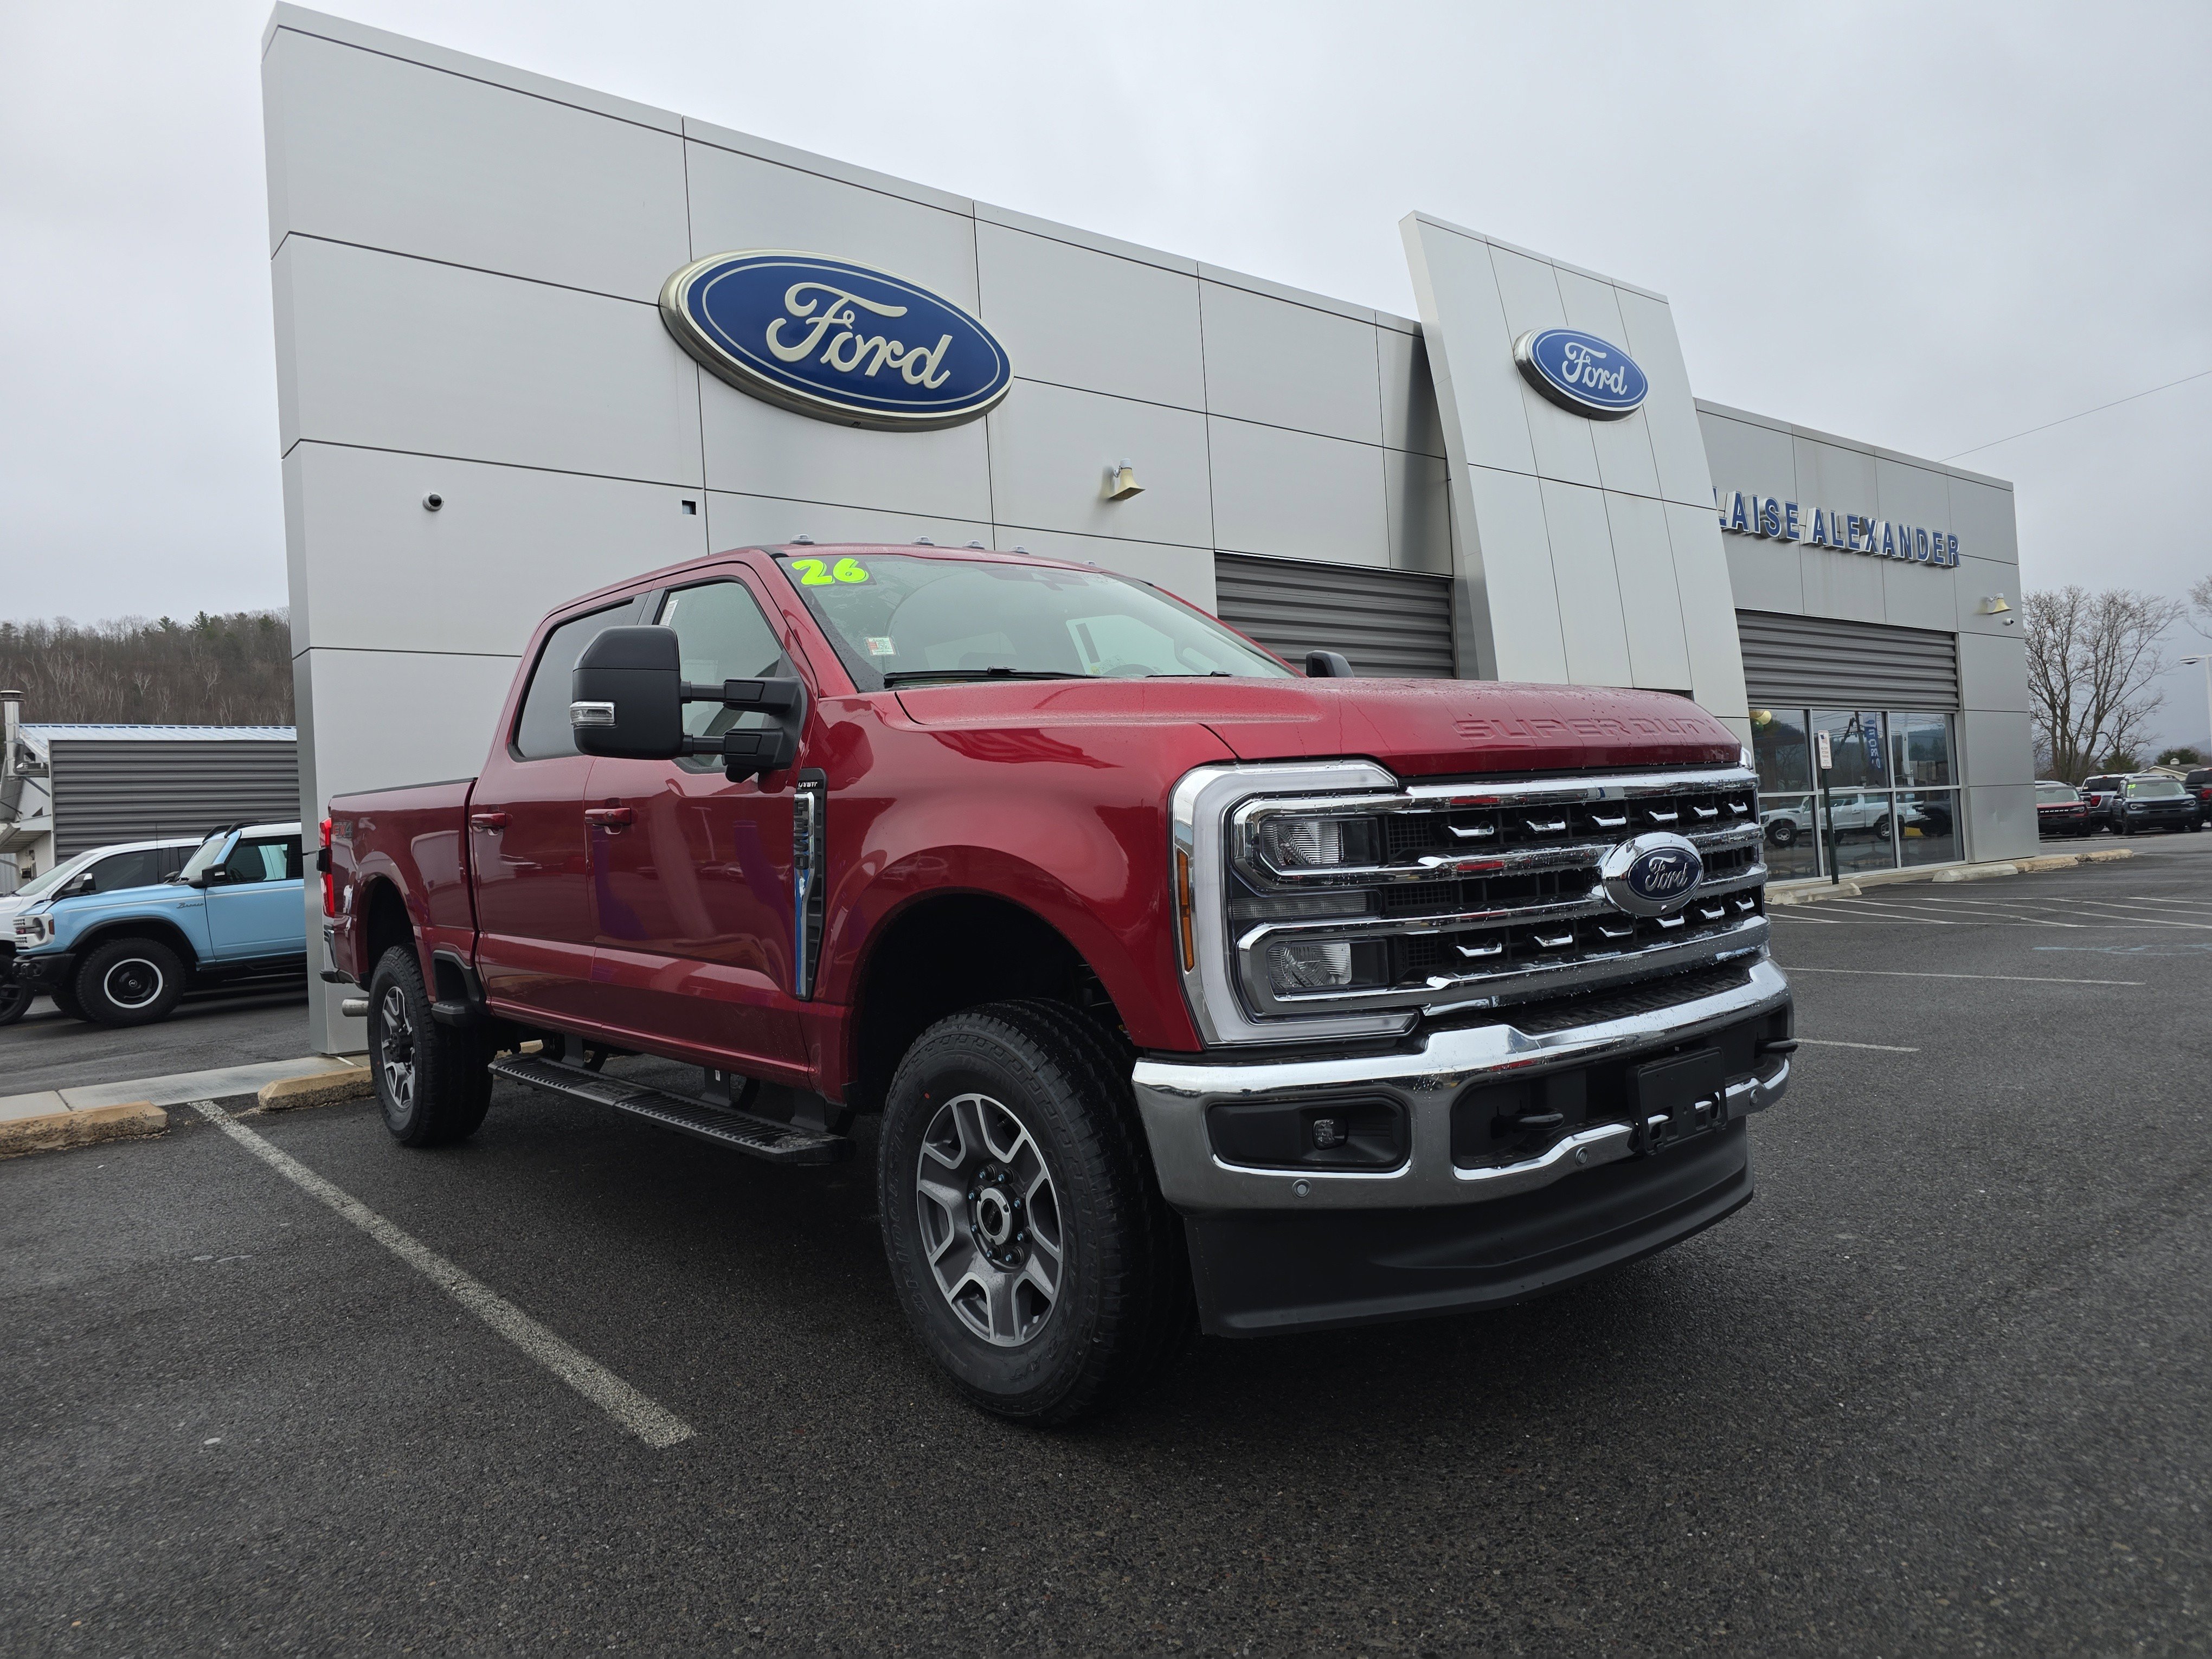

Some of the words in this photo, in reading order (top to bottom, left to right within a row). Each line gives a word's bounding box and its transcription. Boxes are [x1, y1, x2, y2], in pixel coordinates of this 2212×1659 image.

[766, 282, 953, 389] Ford
[1562, 342, 1628, 395] Ford
[1812, 507, 1961, 568] ALEXANDER
[792, 558, 869, 585] 26
[1452, 719, 1631, 740] SUPER
[1632, 718, 1718, 737] DUTY
[1645, 856, 1688, 892] Ford
